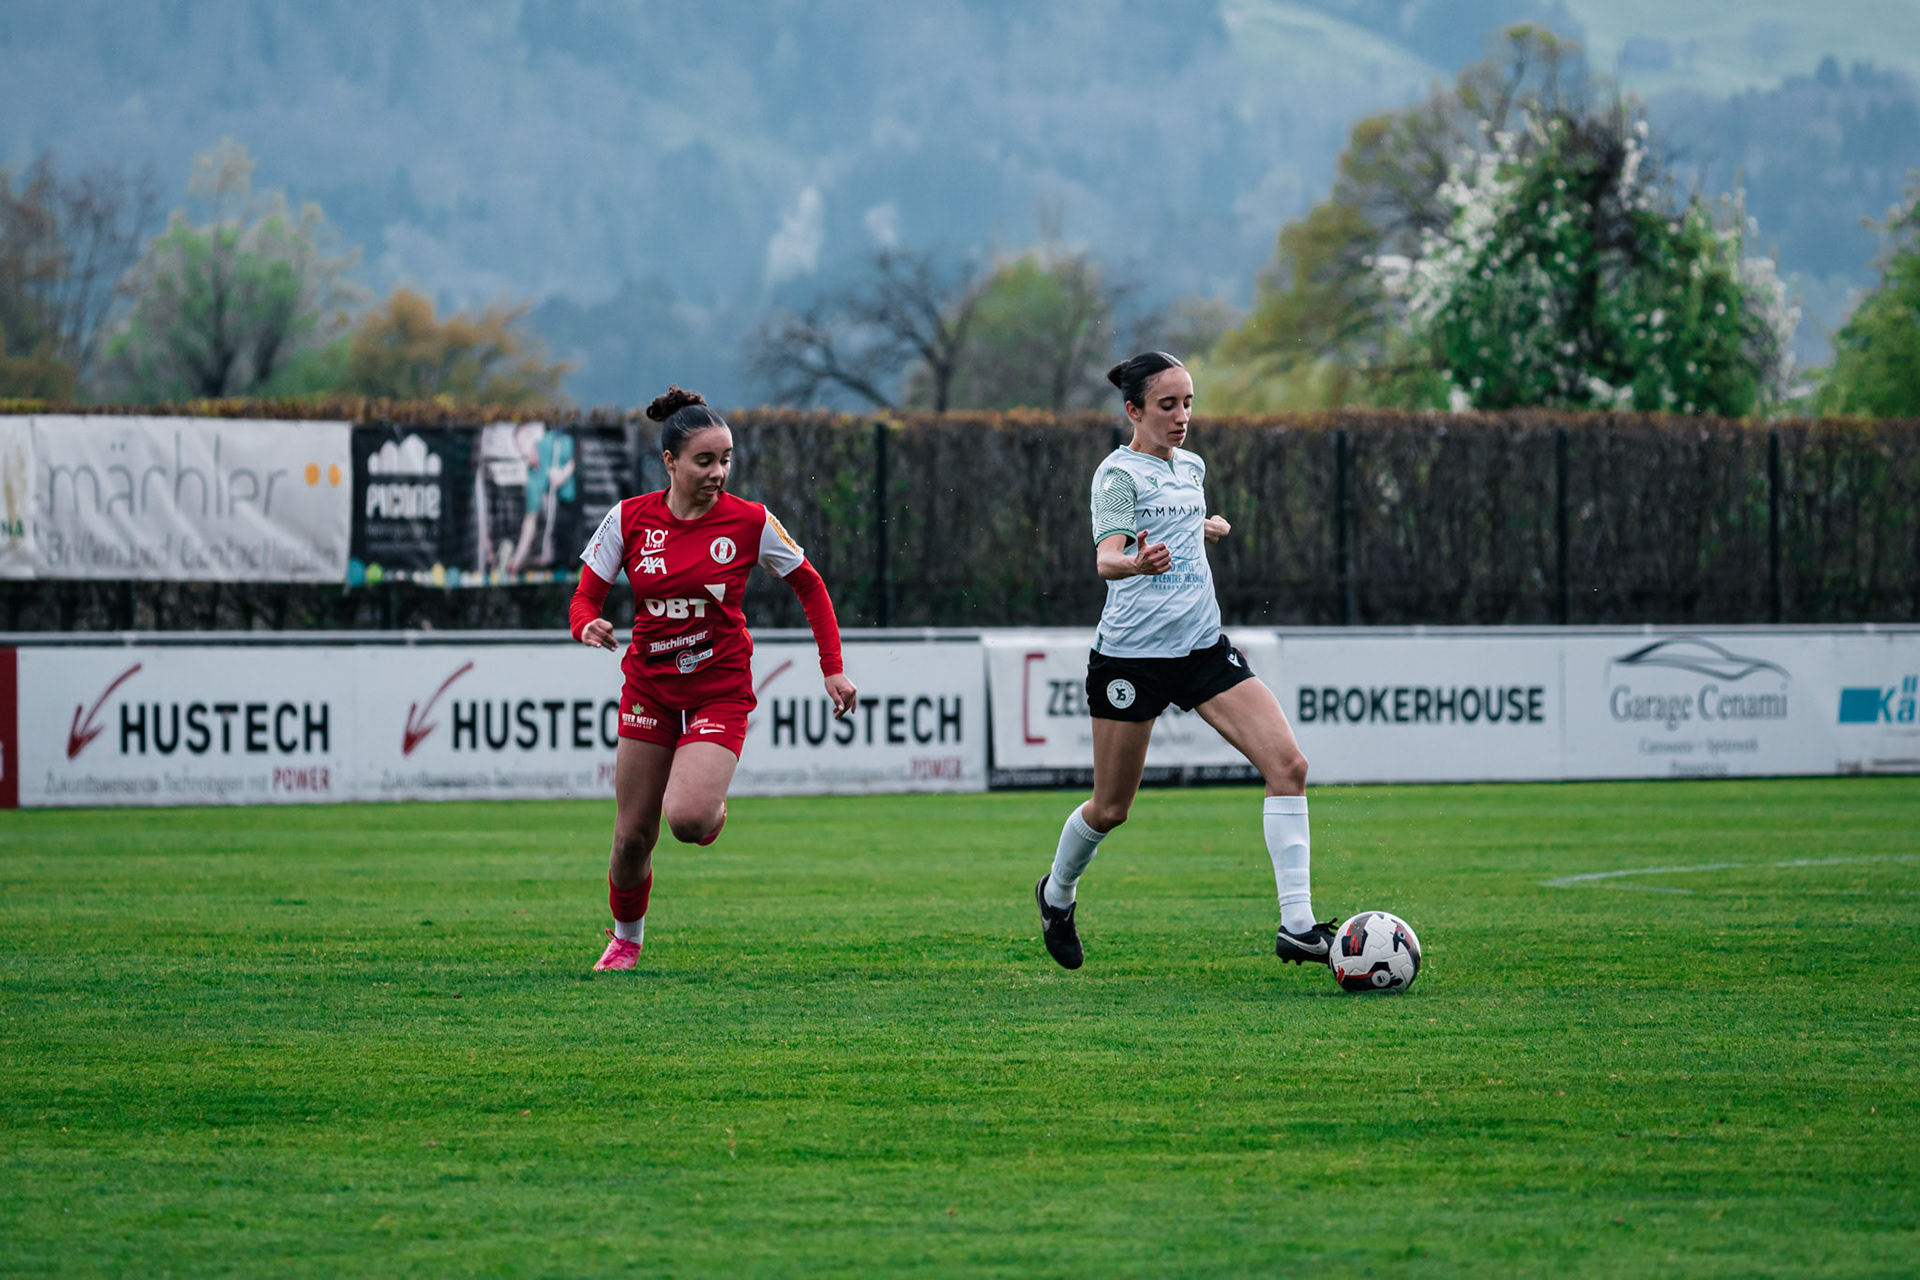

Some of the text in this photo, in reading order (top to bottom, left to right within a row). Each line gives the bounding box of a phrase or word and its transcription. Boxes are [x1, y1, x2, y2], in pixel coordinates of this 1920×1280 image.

[635, 557, 667, 574] AXA
[1299, 688, 1545, 722] BROKERHOUSE
[1610, 683, 1788, 731] Garage Cenami
[1878, 674, 1920, 723] Kä
[120, 703, 329, 754] HUSTECH
[452, 701, 619, 749] HUSTEC
[273, 767, 330, 792] POWER
